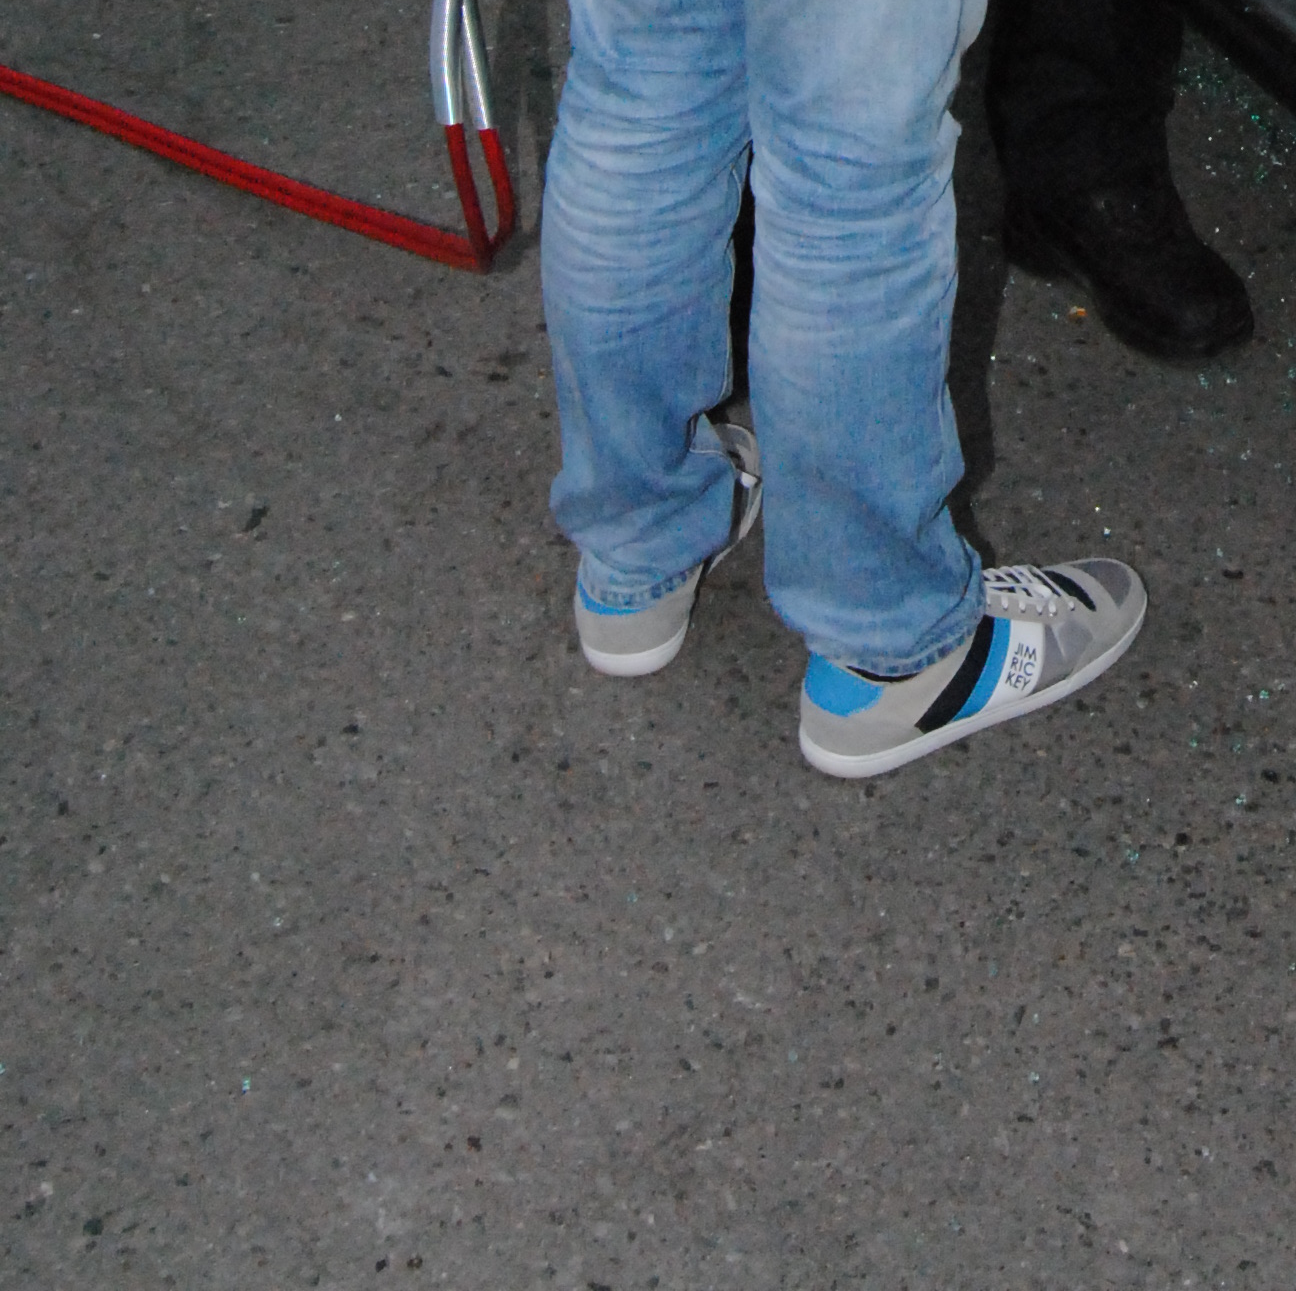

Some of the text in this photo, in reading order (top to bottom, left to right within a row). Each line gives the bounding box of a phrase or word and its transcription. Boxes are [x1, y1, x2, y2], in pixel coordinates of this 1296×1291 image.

[1014, 642, 1037, 662] JIM
[1010, 656, 1036, 677] RIC
[1004, 670, 1031, 691] KEY
